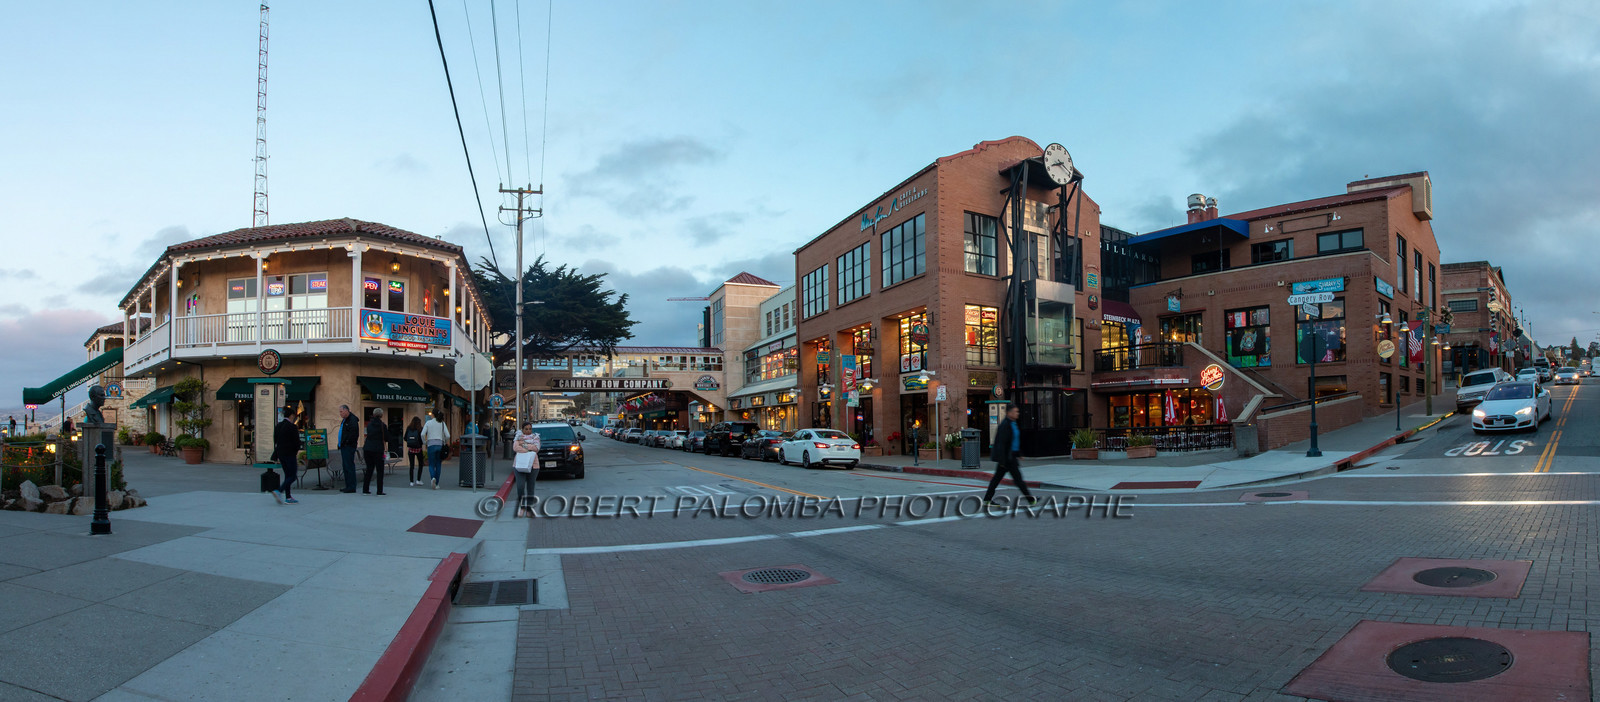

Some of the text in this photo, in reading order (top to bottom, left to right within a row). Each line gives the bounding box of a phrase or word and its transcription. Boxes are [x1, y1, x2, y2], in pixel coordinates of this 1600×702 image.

[1290, 292, 1333, 304] Cannery Row
[405, 314, 436, 328] LOUIE
[1104, 313, 1127, 323] STEINBECK
[392, 323, 448, 338] LINGUINI'S
[52, 388, 67, 398] LOUIE
[66, 374, 92, 391] LINGUINI'S
[560, 380, 663, 388] CANNERY ROW COMPANY
